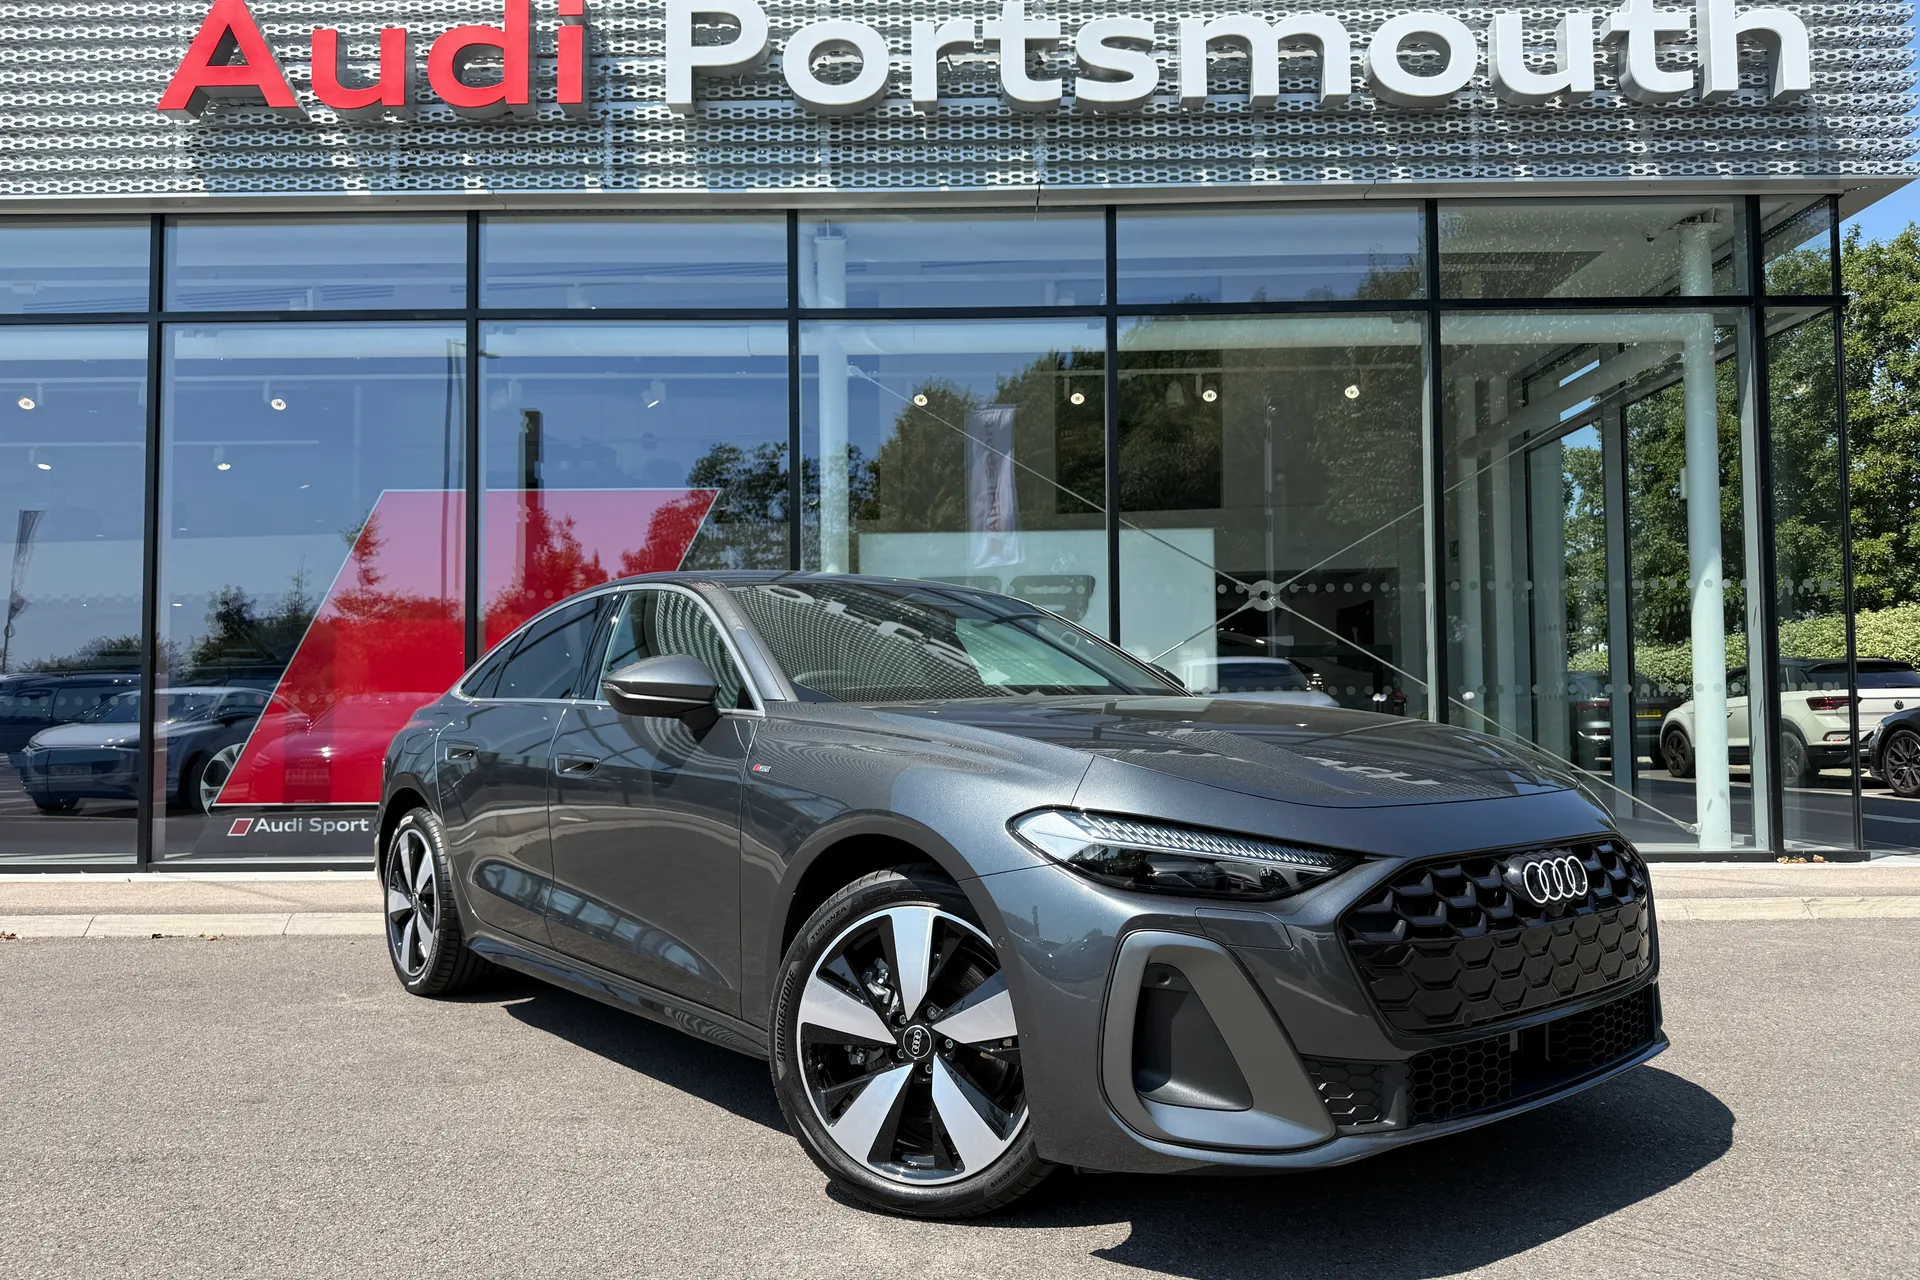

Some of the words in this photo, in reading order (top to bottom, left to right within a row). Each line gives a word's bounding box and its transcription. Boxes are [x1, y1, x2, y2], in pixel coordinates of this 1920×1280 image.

[157, 0, 585, 111] Audi
[665, 0, 1811, 108] Portsmouth
[253, 817, 303, 833] Audi
[309, 817, 370, 836] Sport
[809, 905, 848, 941] TURANZA
[776, 968, 798, 1064] BRIDGESTONE
